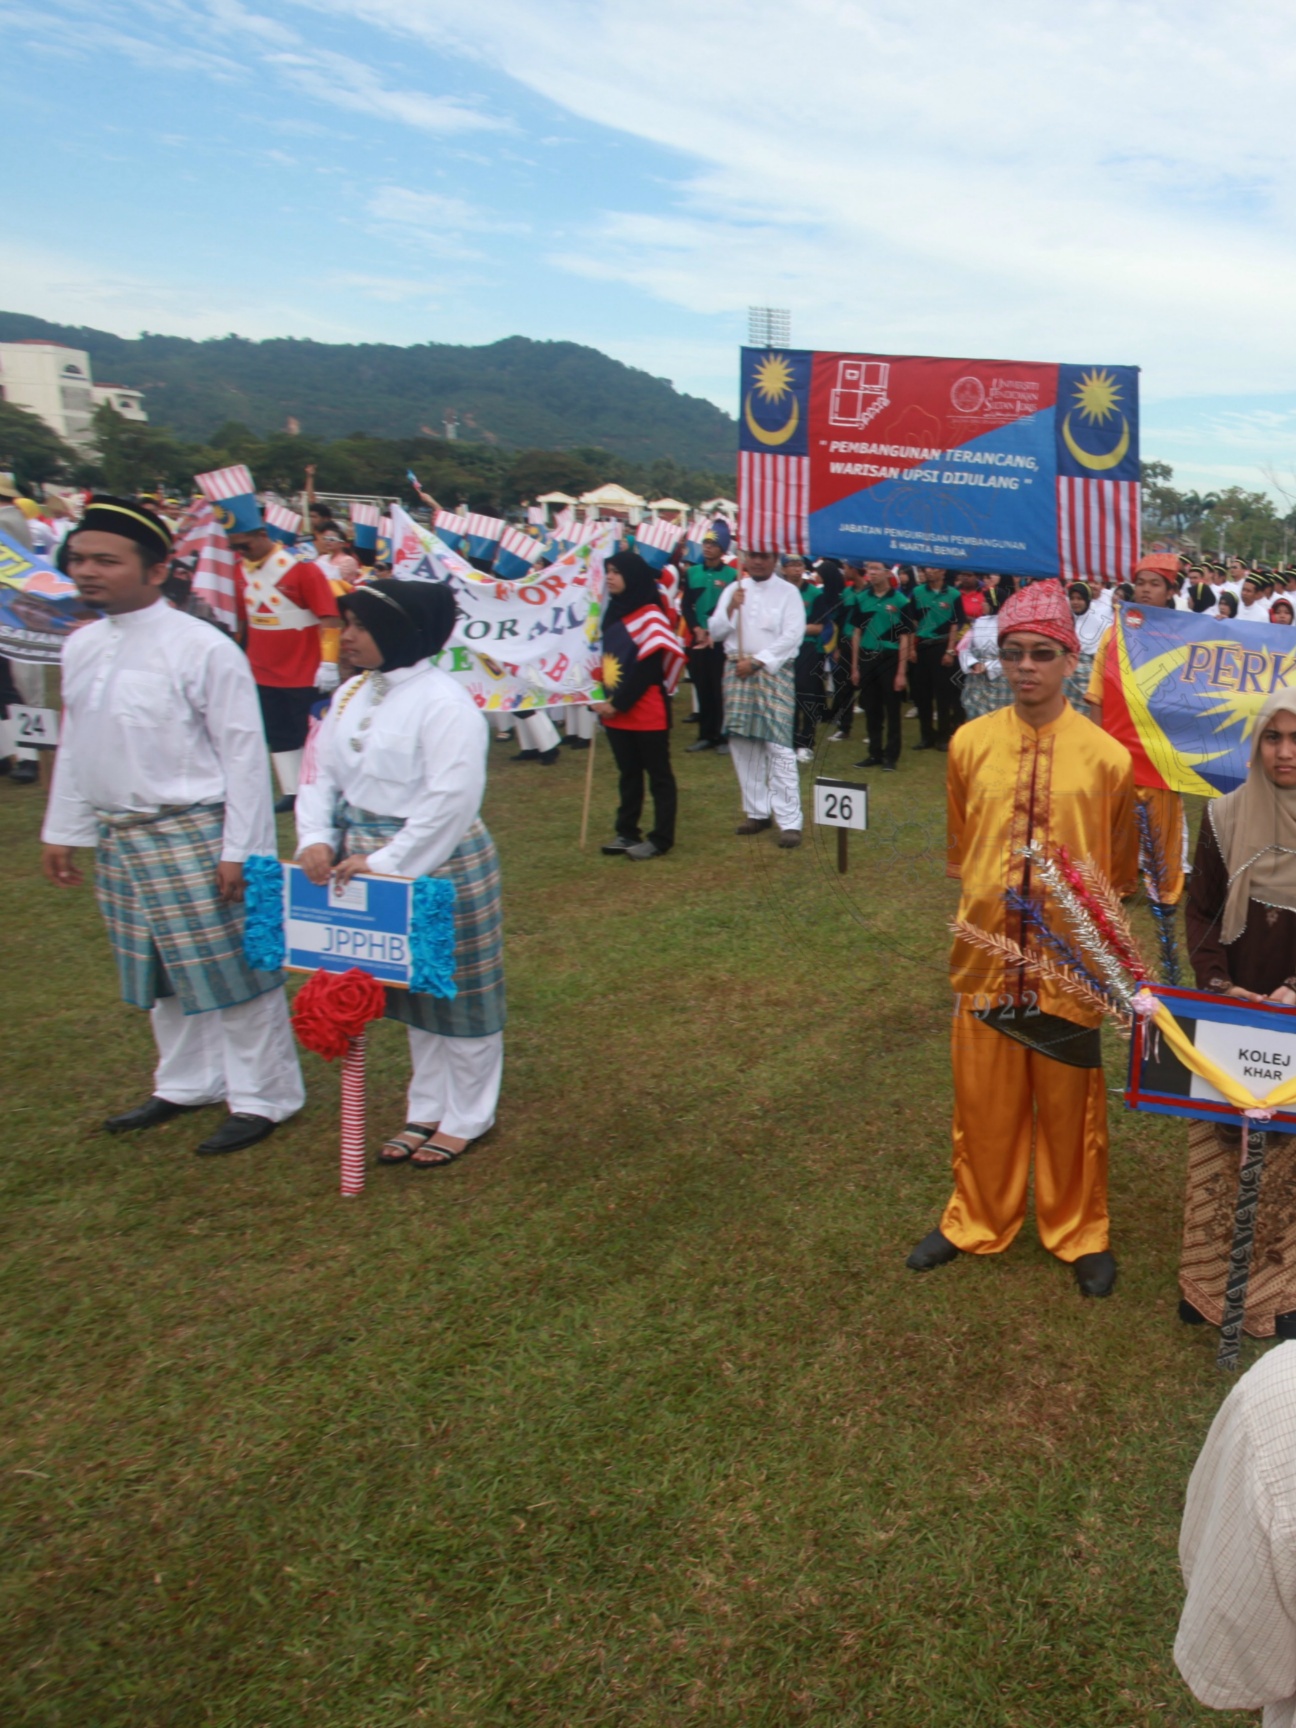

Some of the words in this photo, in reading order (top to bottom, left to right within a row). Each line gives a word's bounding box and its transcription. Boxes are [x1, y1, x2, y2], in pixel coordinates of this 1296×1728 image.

[829, 440, 941, 461] PEMBANGUNAN
[945, 449, 1039, 472] TERANCANG,
[829, 461, 900, 479] WARISAN
[902, 468, 939, 483] UPSI
[941, 471, 1020, 490] DIJULANG
[839, 523, 882, 536] JABATAN
[884, 528, 949, 543] PENGURUSAN
[950, 535, 1027, 550] PEMBANGUNAN
[899, 543, 932, 553] HARTA
[934, 546, 967, 557] BENDA
[494, 575, 568, 606] FOR
[18, 712, 46, 737] 24
[825, 793, 852, 820] 26
[321, 927, 405, 961] JPPHB
[1239, 1048, 1291, 1067] KOLEJ
[1244, 1066, 1282, 1080] KHAR
